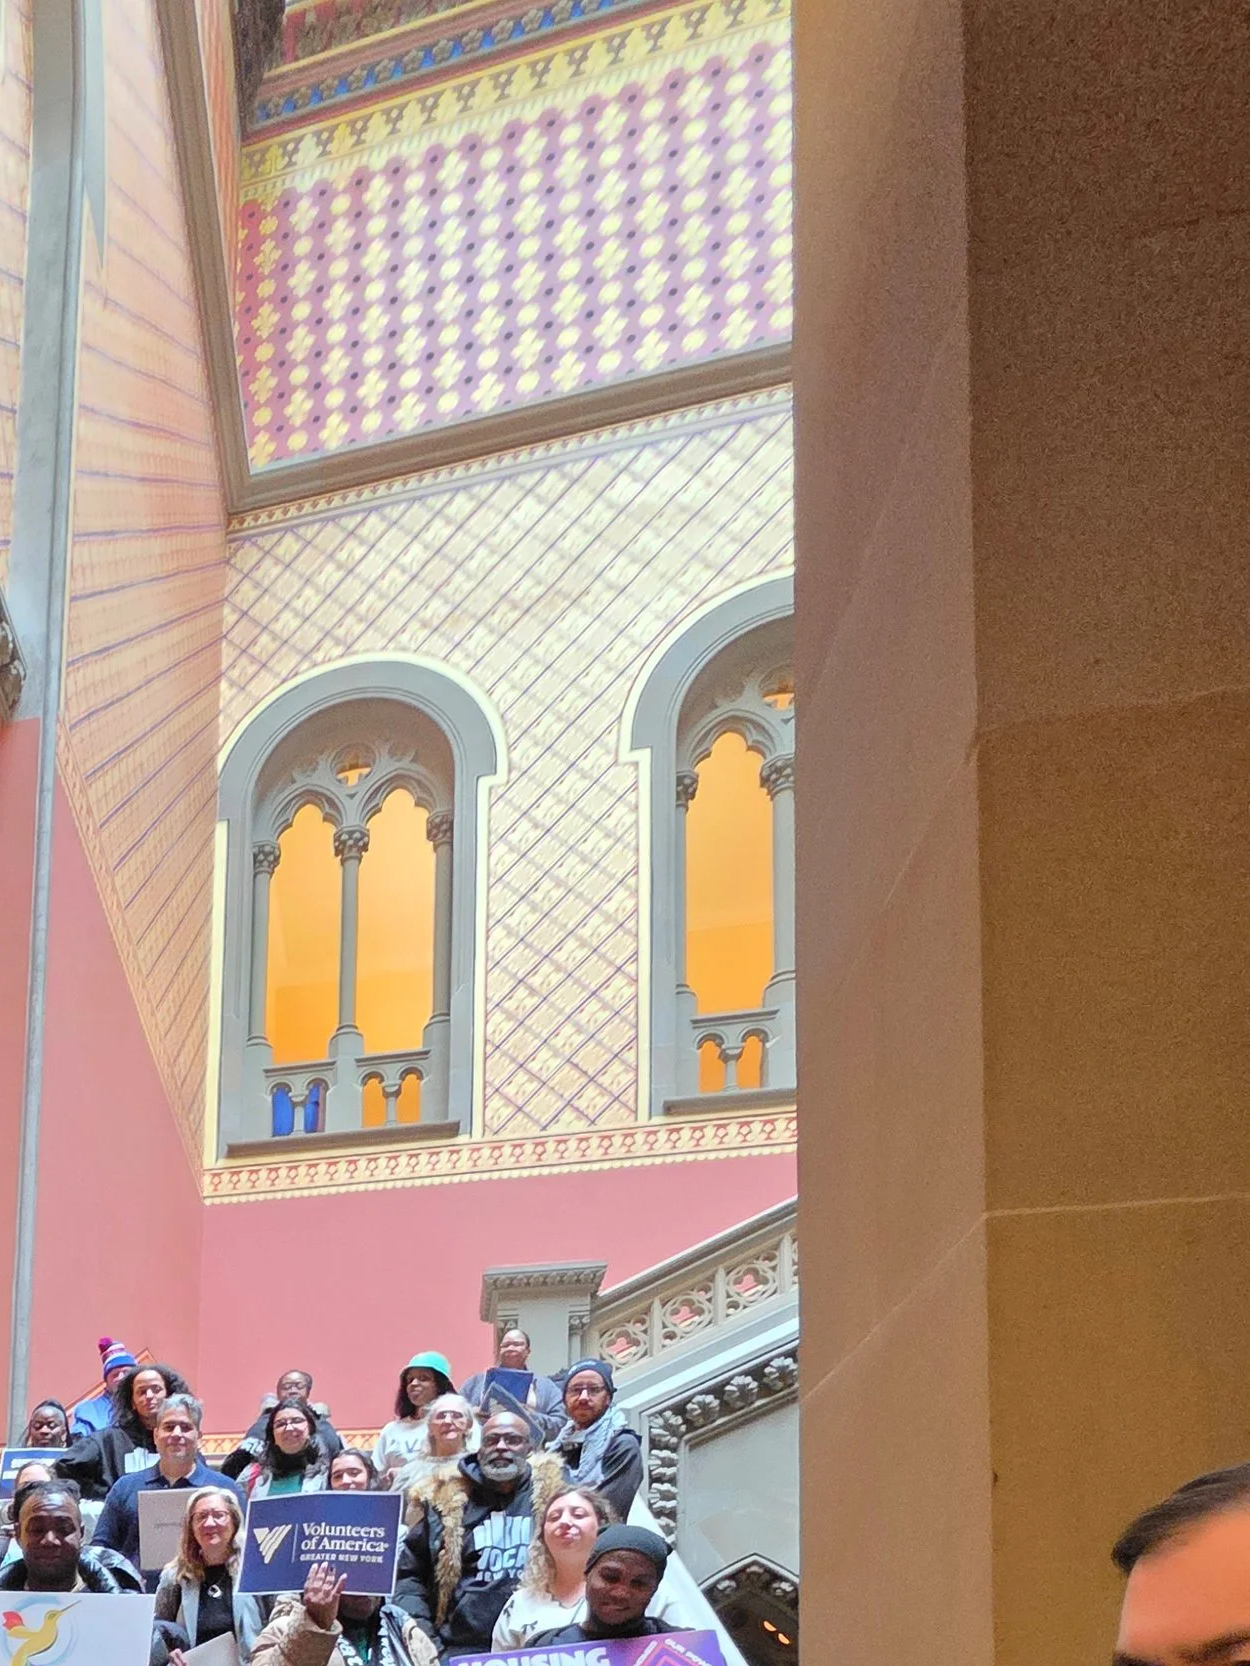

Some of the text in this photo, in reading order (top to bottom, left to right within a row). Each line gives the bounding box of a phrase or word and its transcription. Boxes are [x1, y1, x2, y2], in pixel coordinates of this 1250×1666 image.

[302, 1522, 385, 1537] Volunteers
[301, 1536, 319, 1550] of
[300, 1553, 383, 1563] GREATER NEW YORK
